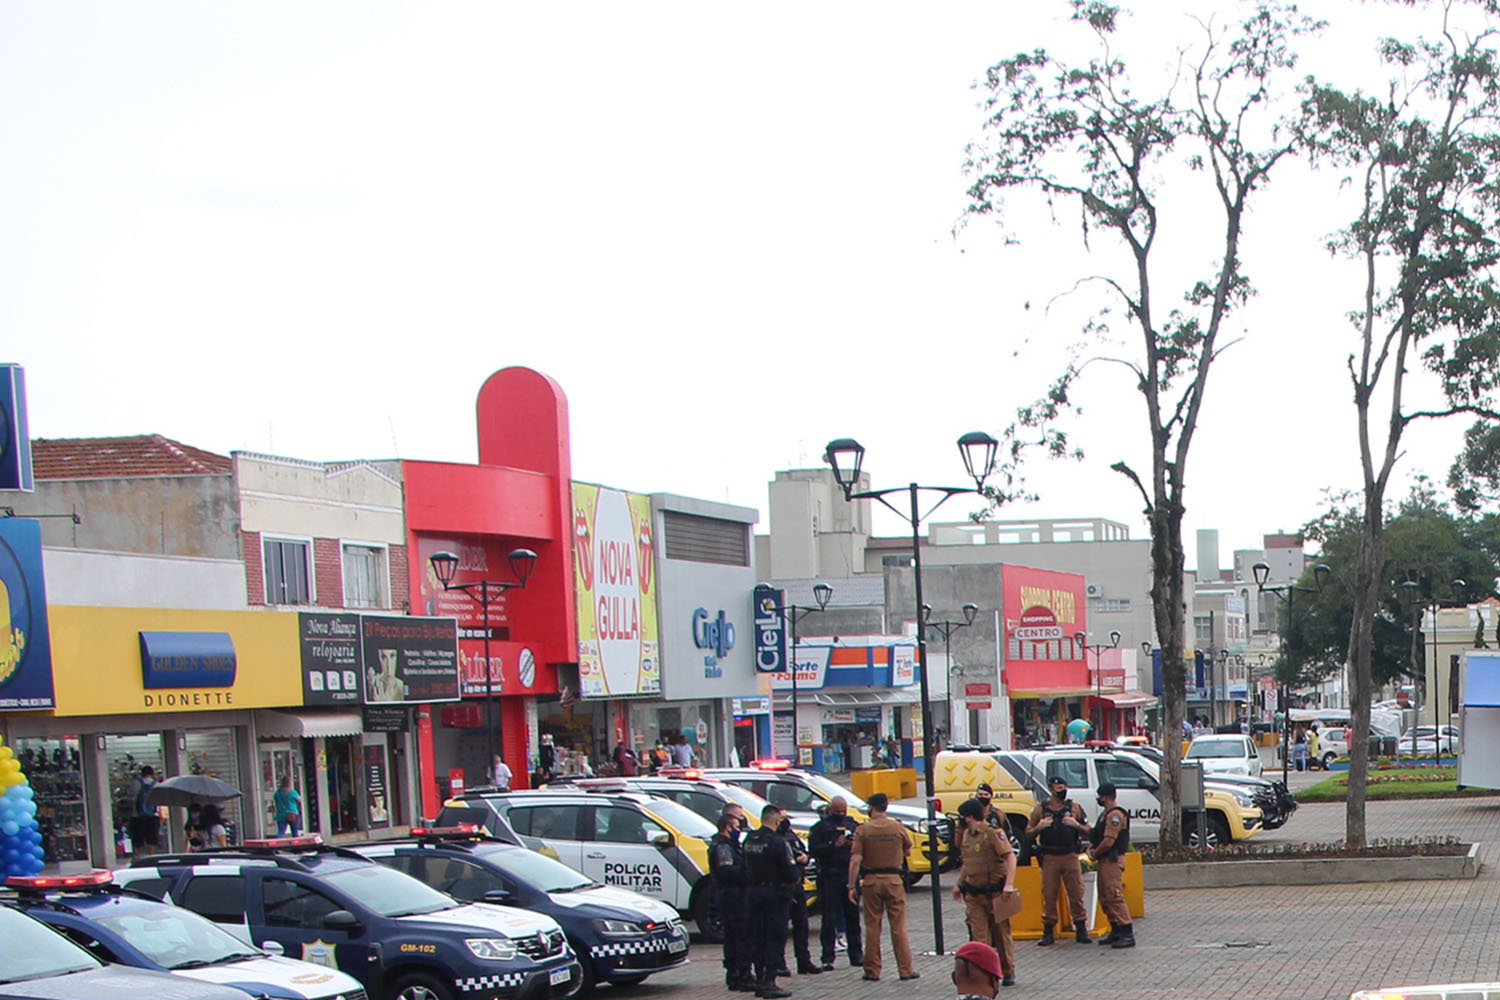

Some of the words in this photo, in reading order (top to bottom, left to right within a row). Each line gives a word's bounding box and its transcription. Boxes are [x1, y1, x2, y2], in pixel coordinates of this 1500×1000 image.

[600, 540, 632, 586] NOVA
[599, 596, 639, 640] GULLA
[307, 619, 328, 634] Nova
[329, 618, 356, 636] Aliança
[1017, 628, 1060, 638] CENTRO
[144, 692, 233, 707] DIONETTE
[604, 875, 661, 886] MILITAR
[400, 944, 436, 953] GM-102
